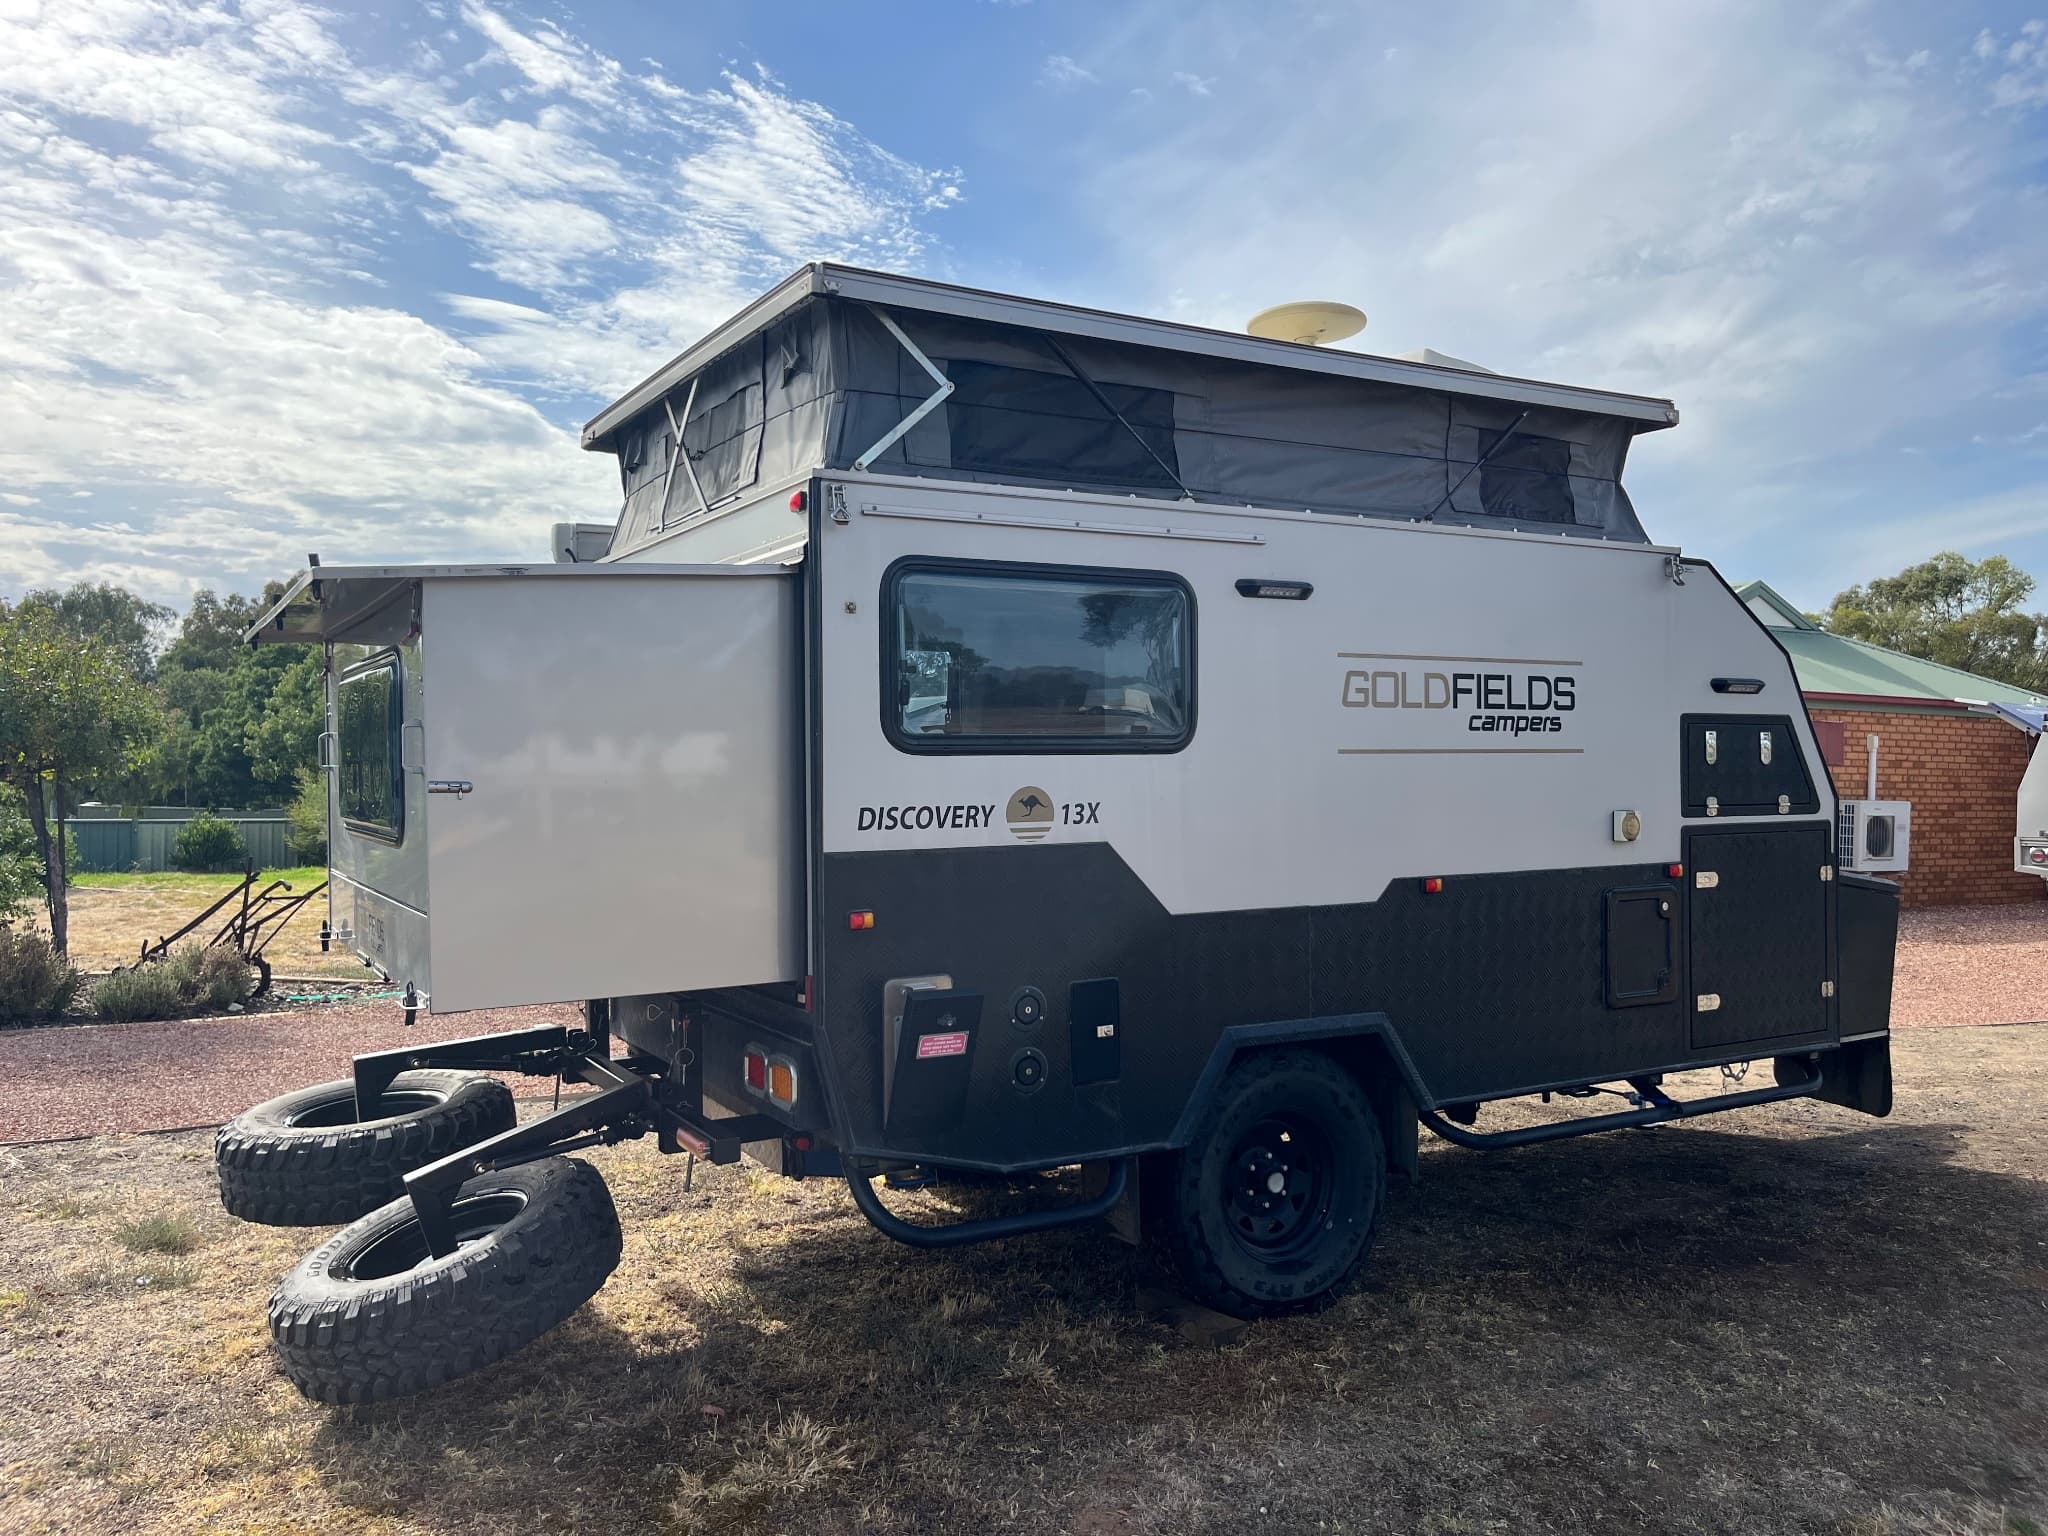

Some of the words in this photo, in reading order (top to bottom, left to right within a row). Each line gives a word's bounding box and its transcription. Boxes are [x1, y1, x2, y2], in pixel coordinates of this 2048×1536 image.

[1342, 670, 1576, 711] GOLDFIELDS
[1469, 714, 1562, 737] campers
[857, 805, 995, 831] DISCOVERY
[1061, 802, 1101, 825] 13X
